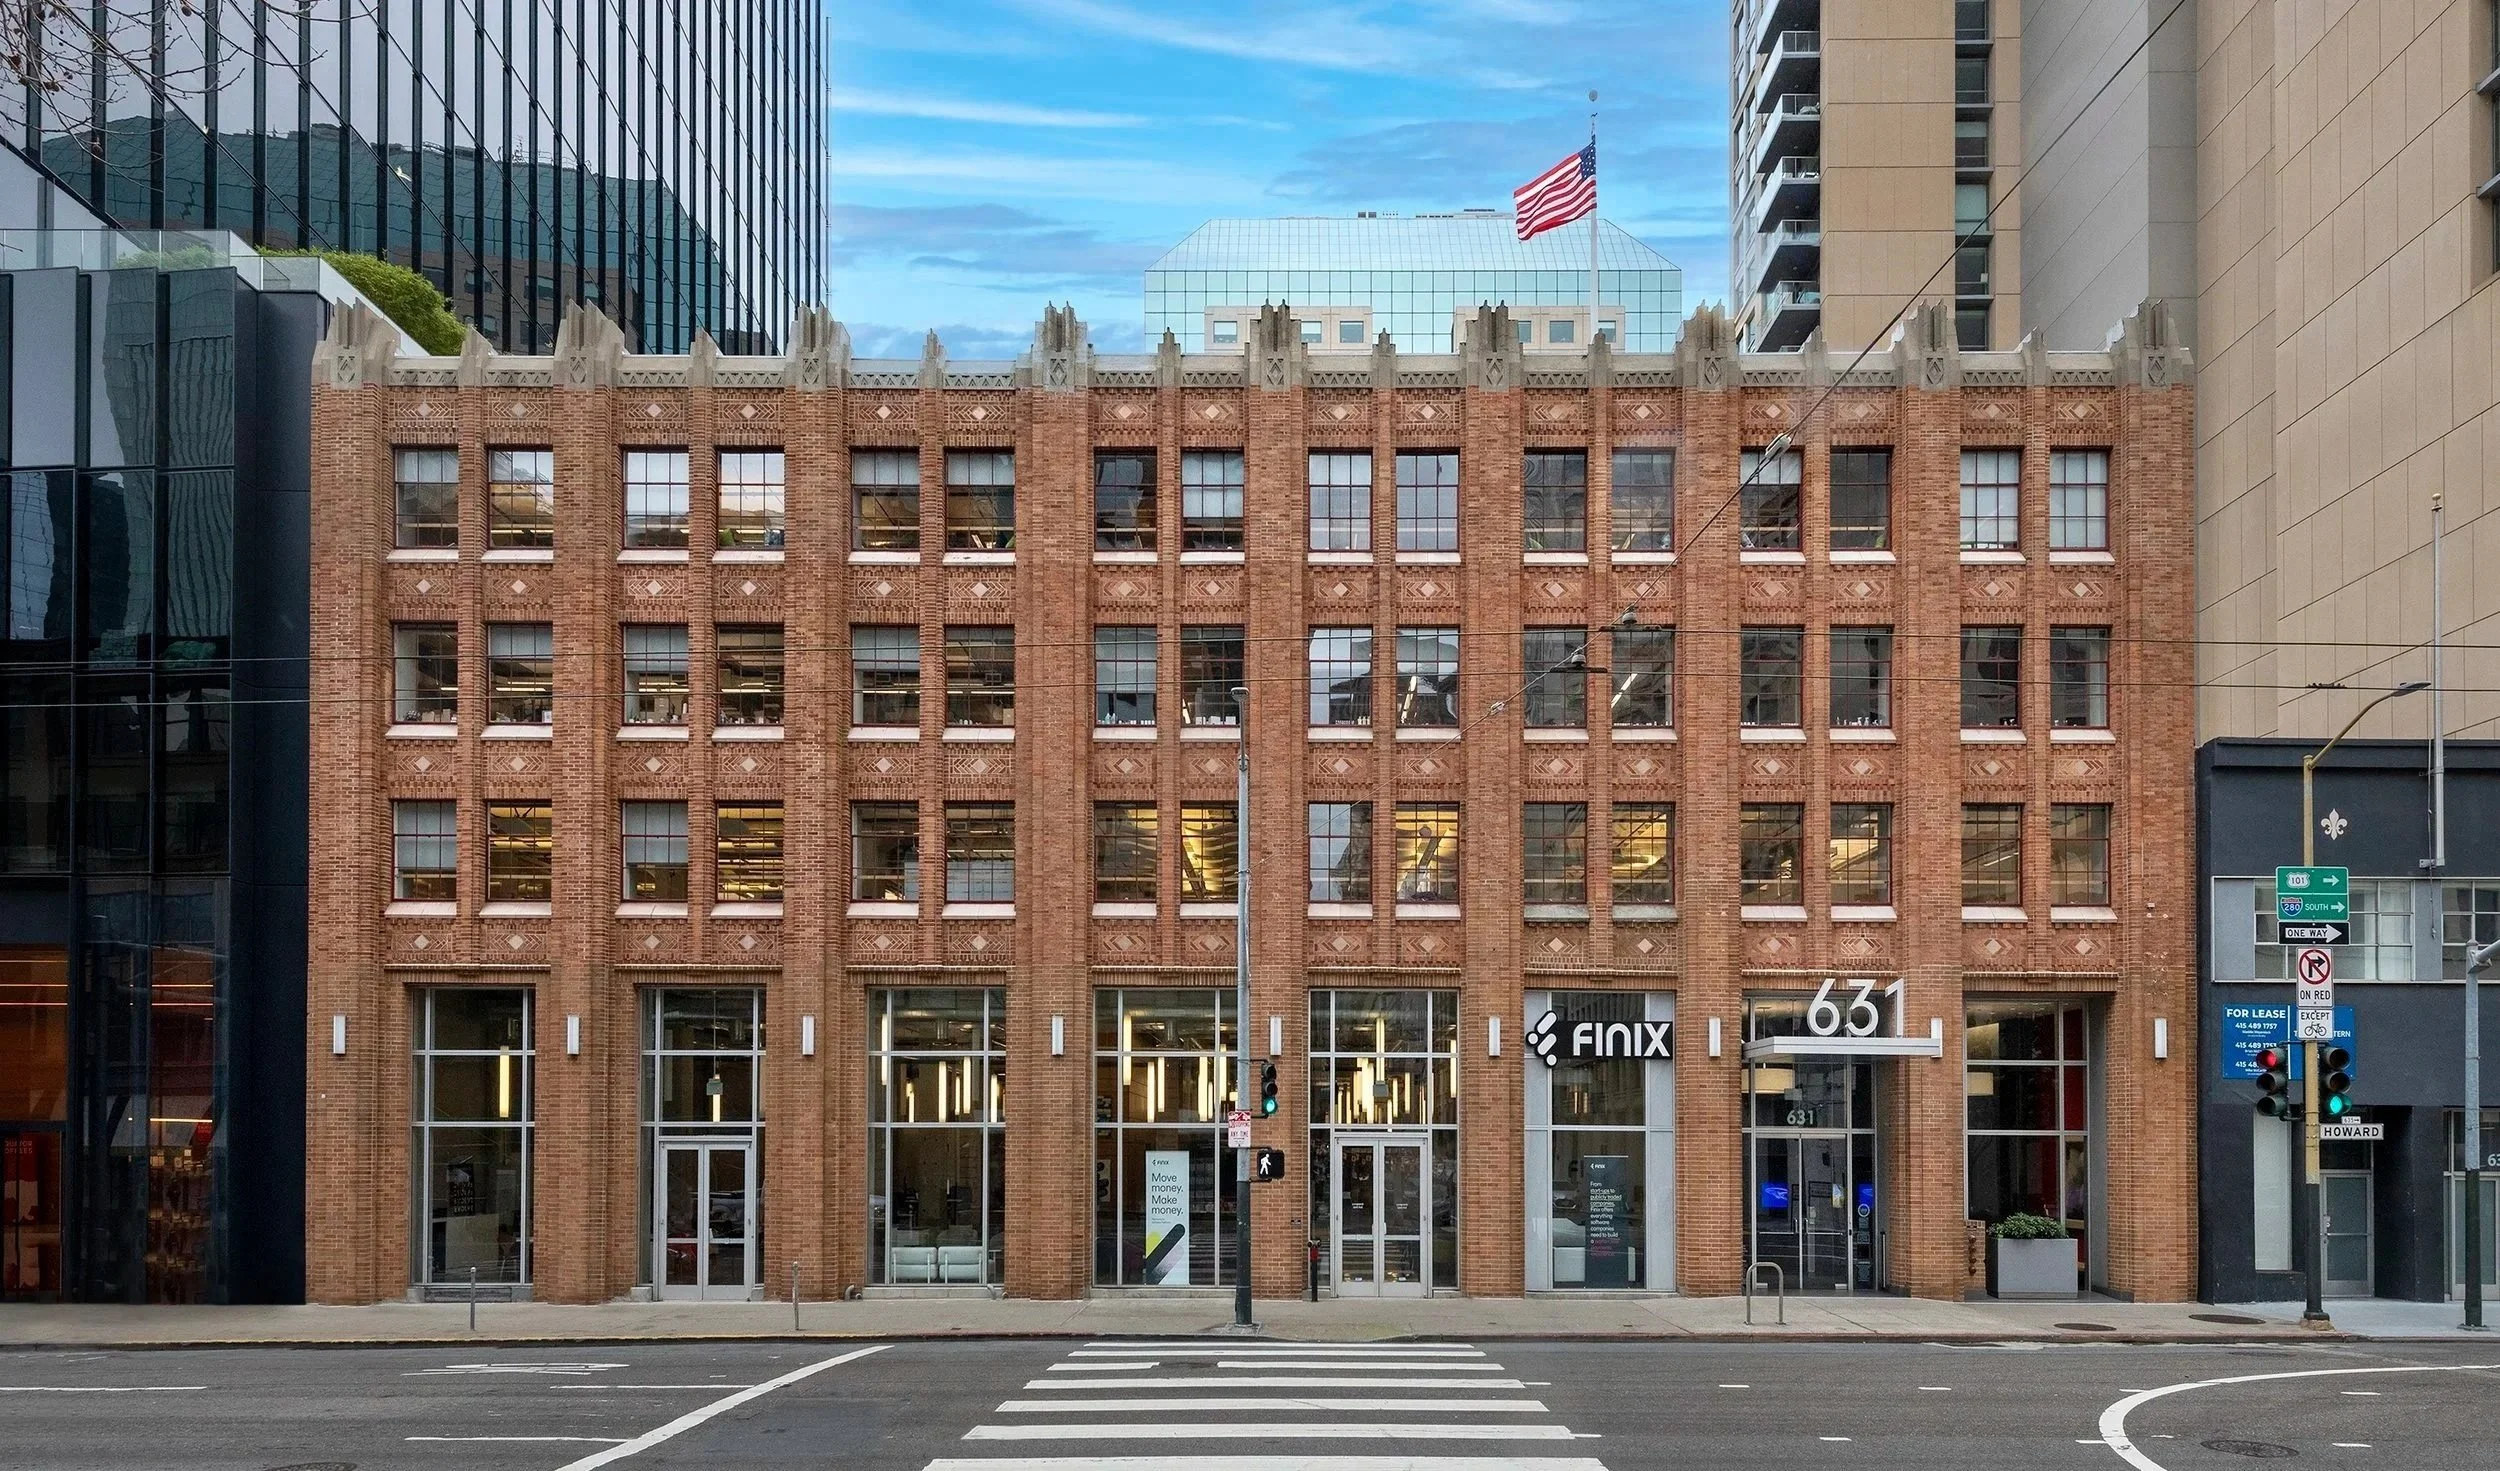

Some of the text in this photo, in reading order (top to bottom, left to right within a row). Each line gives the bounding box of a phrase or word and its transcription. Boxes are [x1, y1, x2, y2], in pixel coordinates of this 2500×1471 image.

[2284, 903, 2328, 911] 280 SOUTH
[2287, 929, 2328, 937] ONE WAY
[2300, 990, 2331, 1000] ON RED
[1807, 978, 1903, 1037] 631
[2226, 1009, 2286, 1019] FOR LEASE
[2300, 1012, 2330, 1020] EXCEPT
[1573, 1022, 1670, 1057] FINIX
[1786, 1110, 1814, 1125] 631
[2324, 1127, 2379, 1137] HOWARD
[1152, 1173, 1177, 1182] Move
[1152, 1185, 1183, 1194] money.
[1152, 1195, 1177, 1204] Make
[1152, 1207, 1183, 1216] money.
